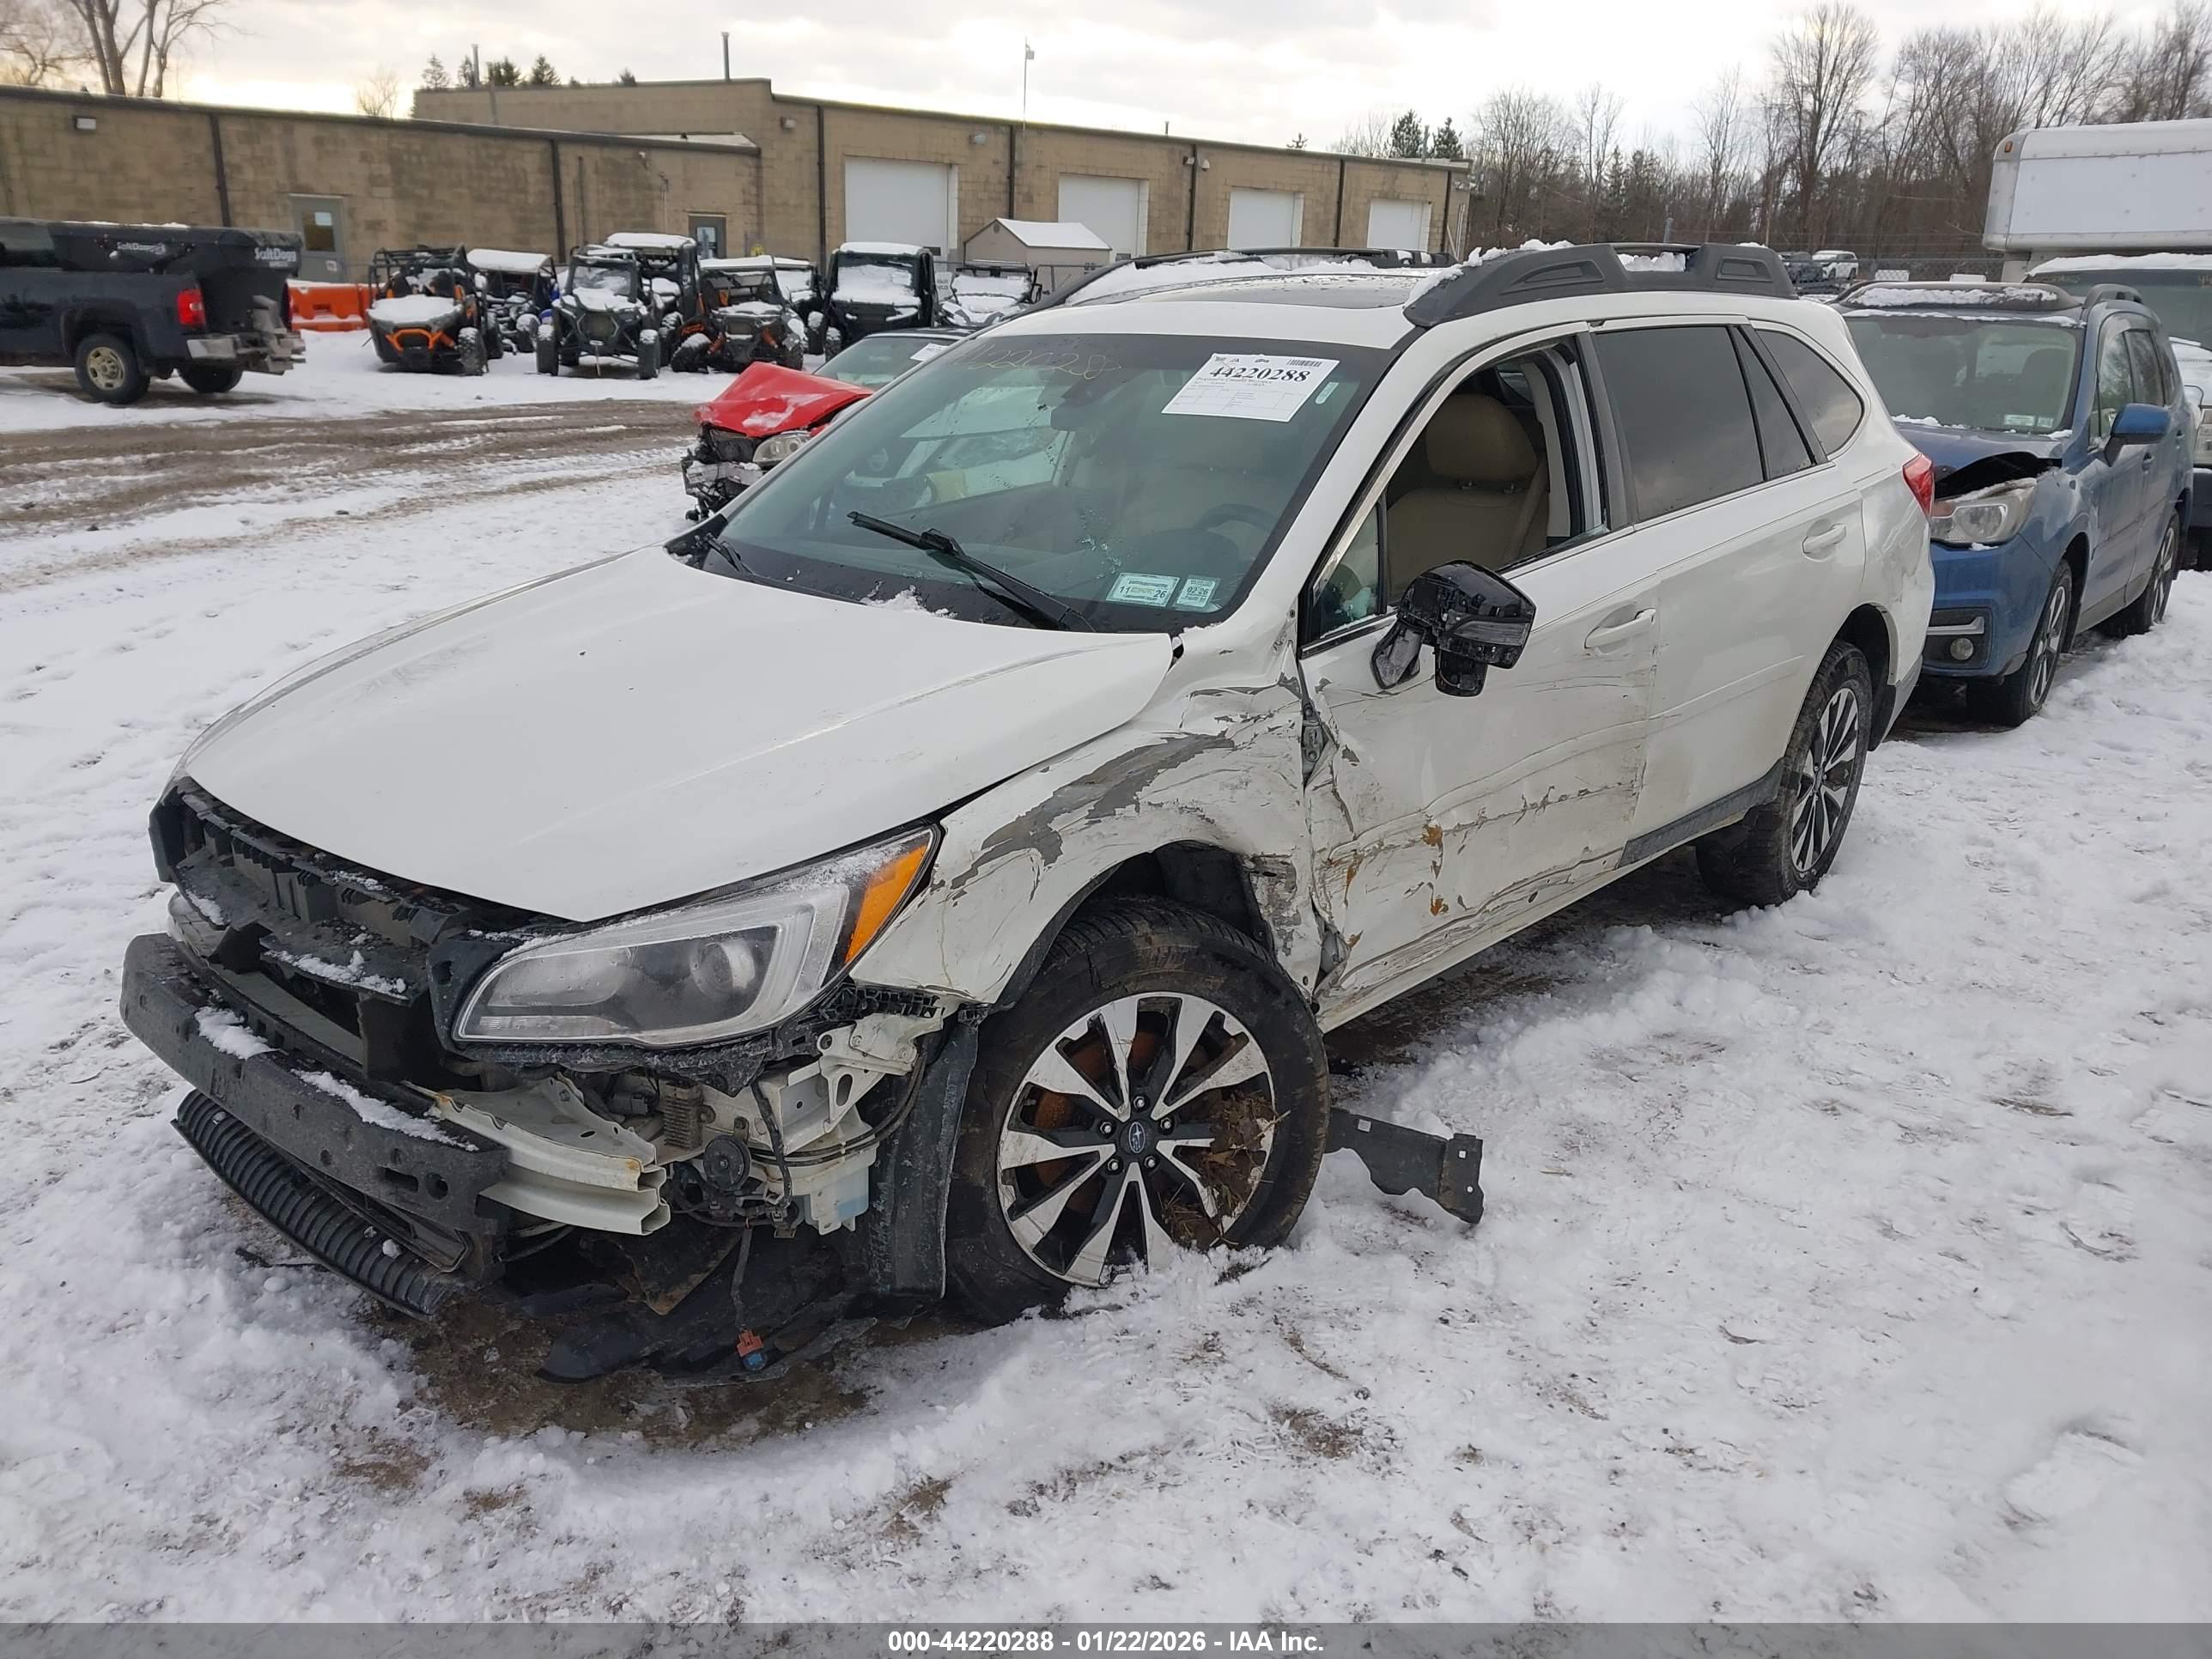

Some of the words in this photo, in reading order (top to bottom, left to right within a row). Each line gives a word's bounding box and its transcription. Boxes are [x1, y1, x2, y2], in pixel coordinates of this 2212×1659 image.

[254, 247, 296, 261] SaltDogg
[1210, 366, 1311, 382] 44220288
[1120, 586, 1130, 594] 11
[1153, 589, 1167, 599] 26
